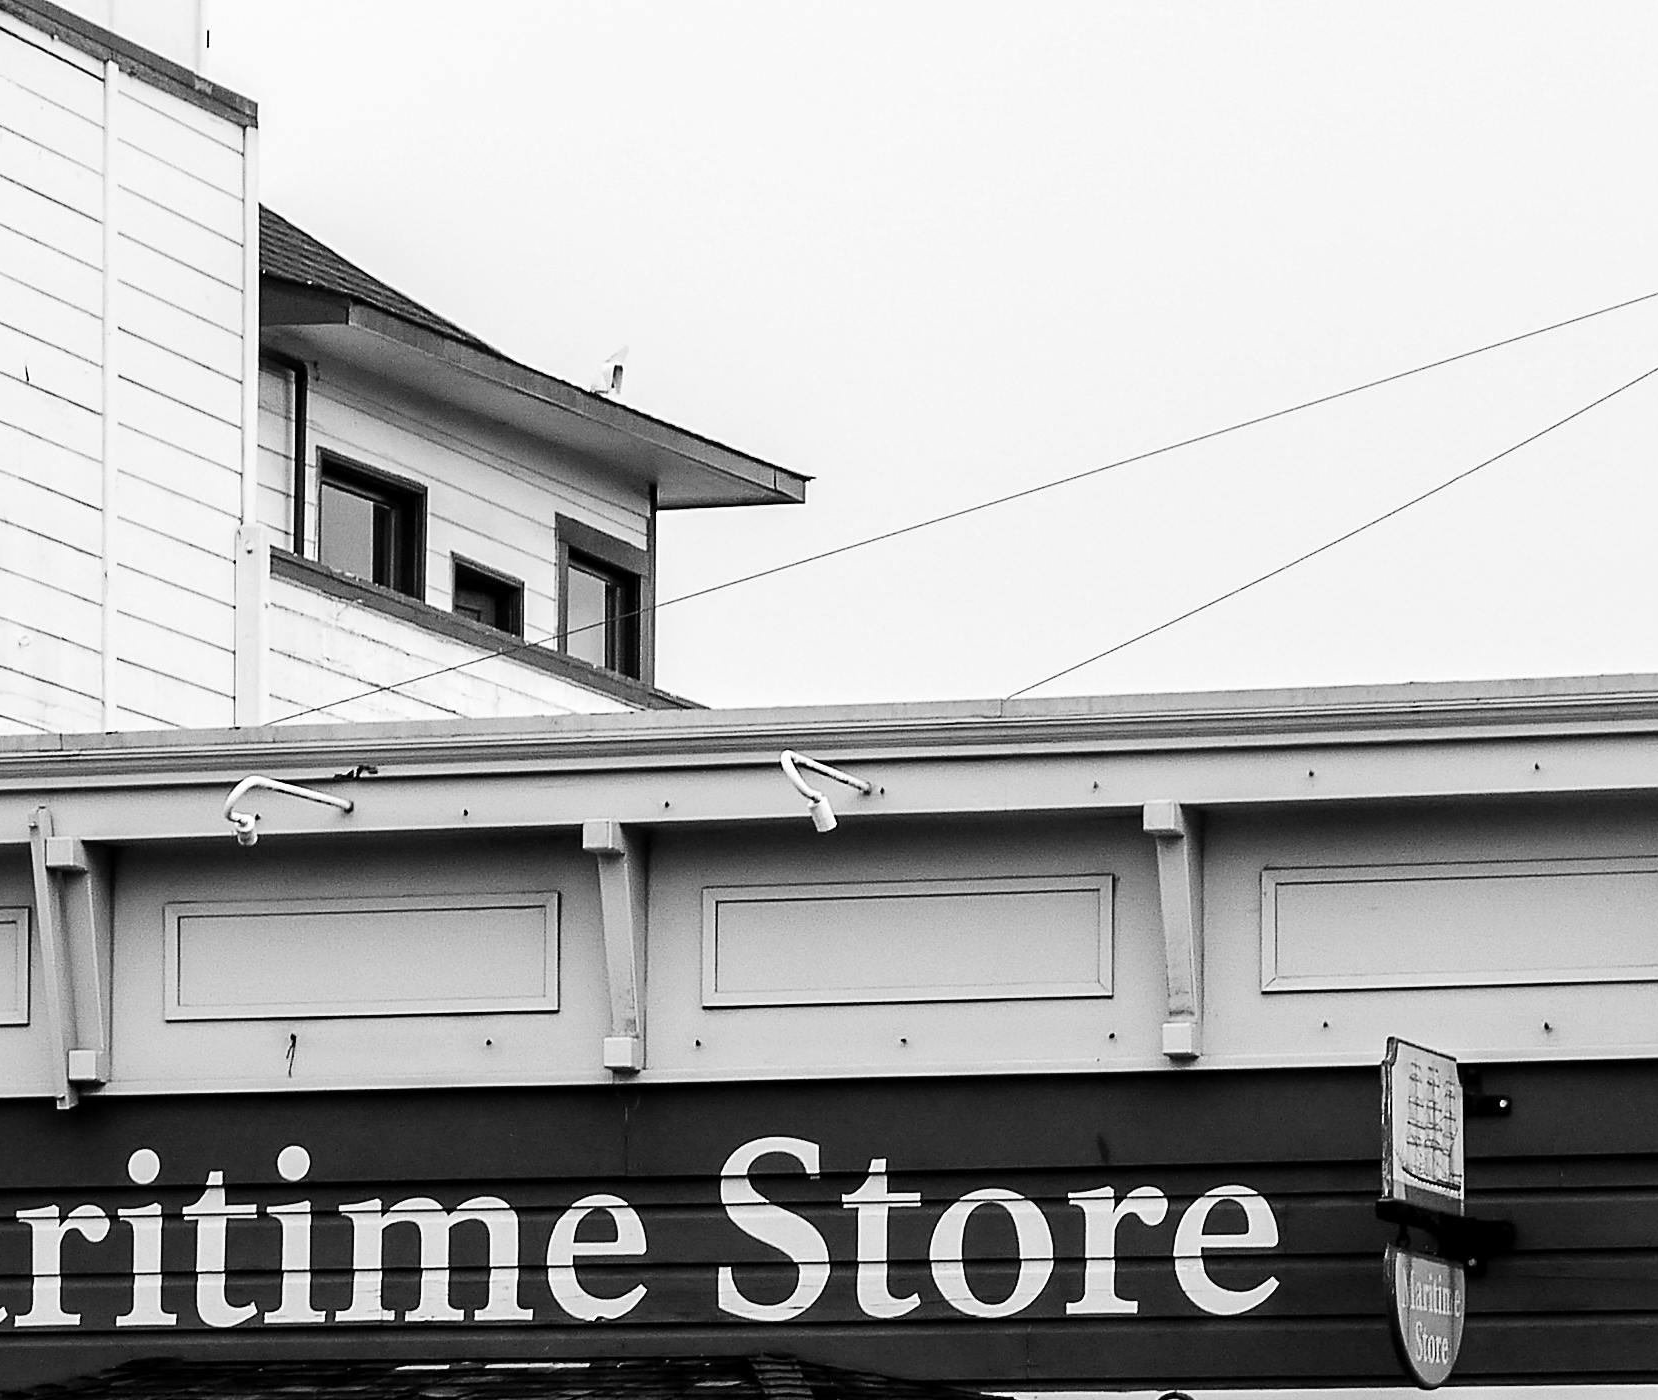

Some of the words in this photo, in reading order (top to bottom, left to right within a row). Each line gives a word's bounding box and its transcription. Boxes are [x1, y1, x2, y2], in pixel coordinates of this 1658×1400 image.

[717, 1136, 1280, 1322] Store
[1402, 1266, 1462, 1318] Maritime
[1415, 1320, 1450, 1365] Store
